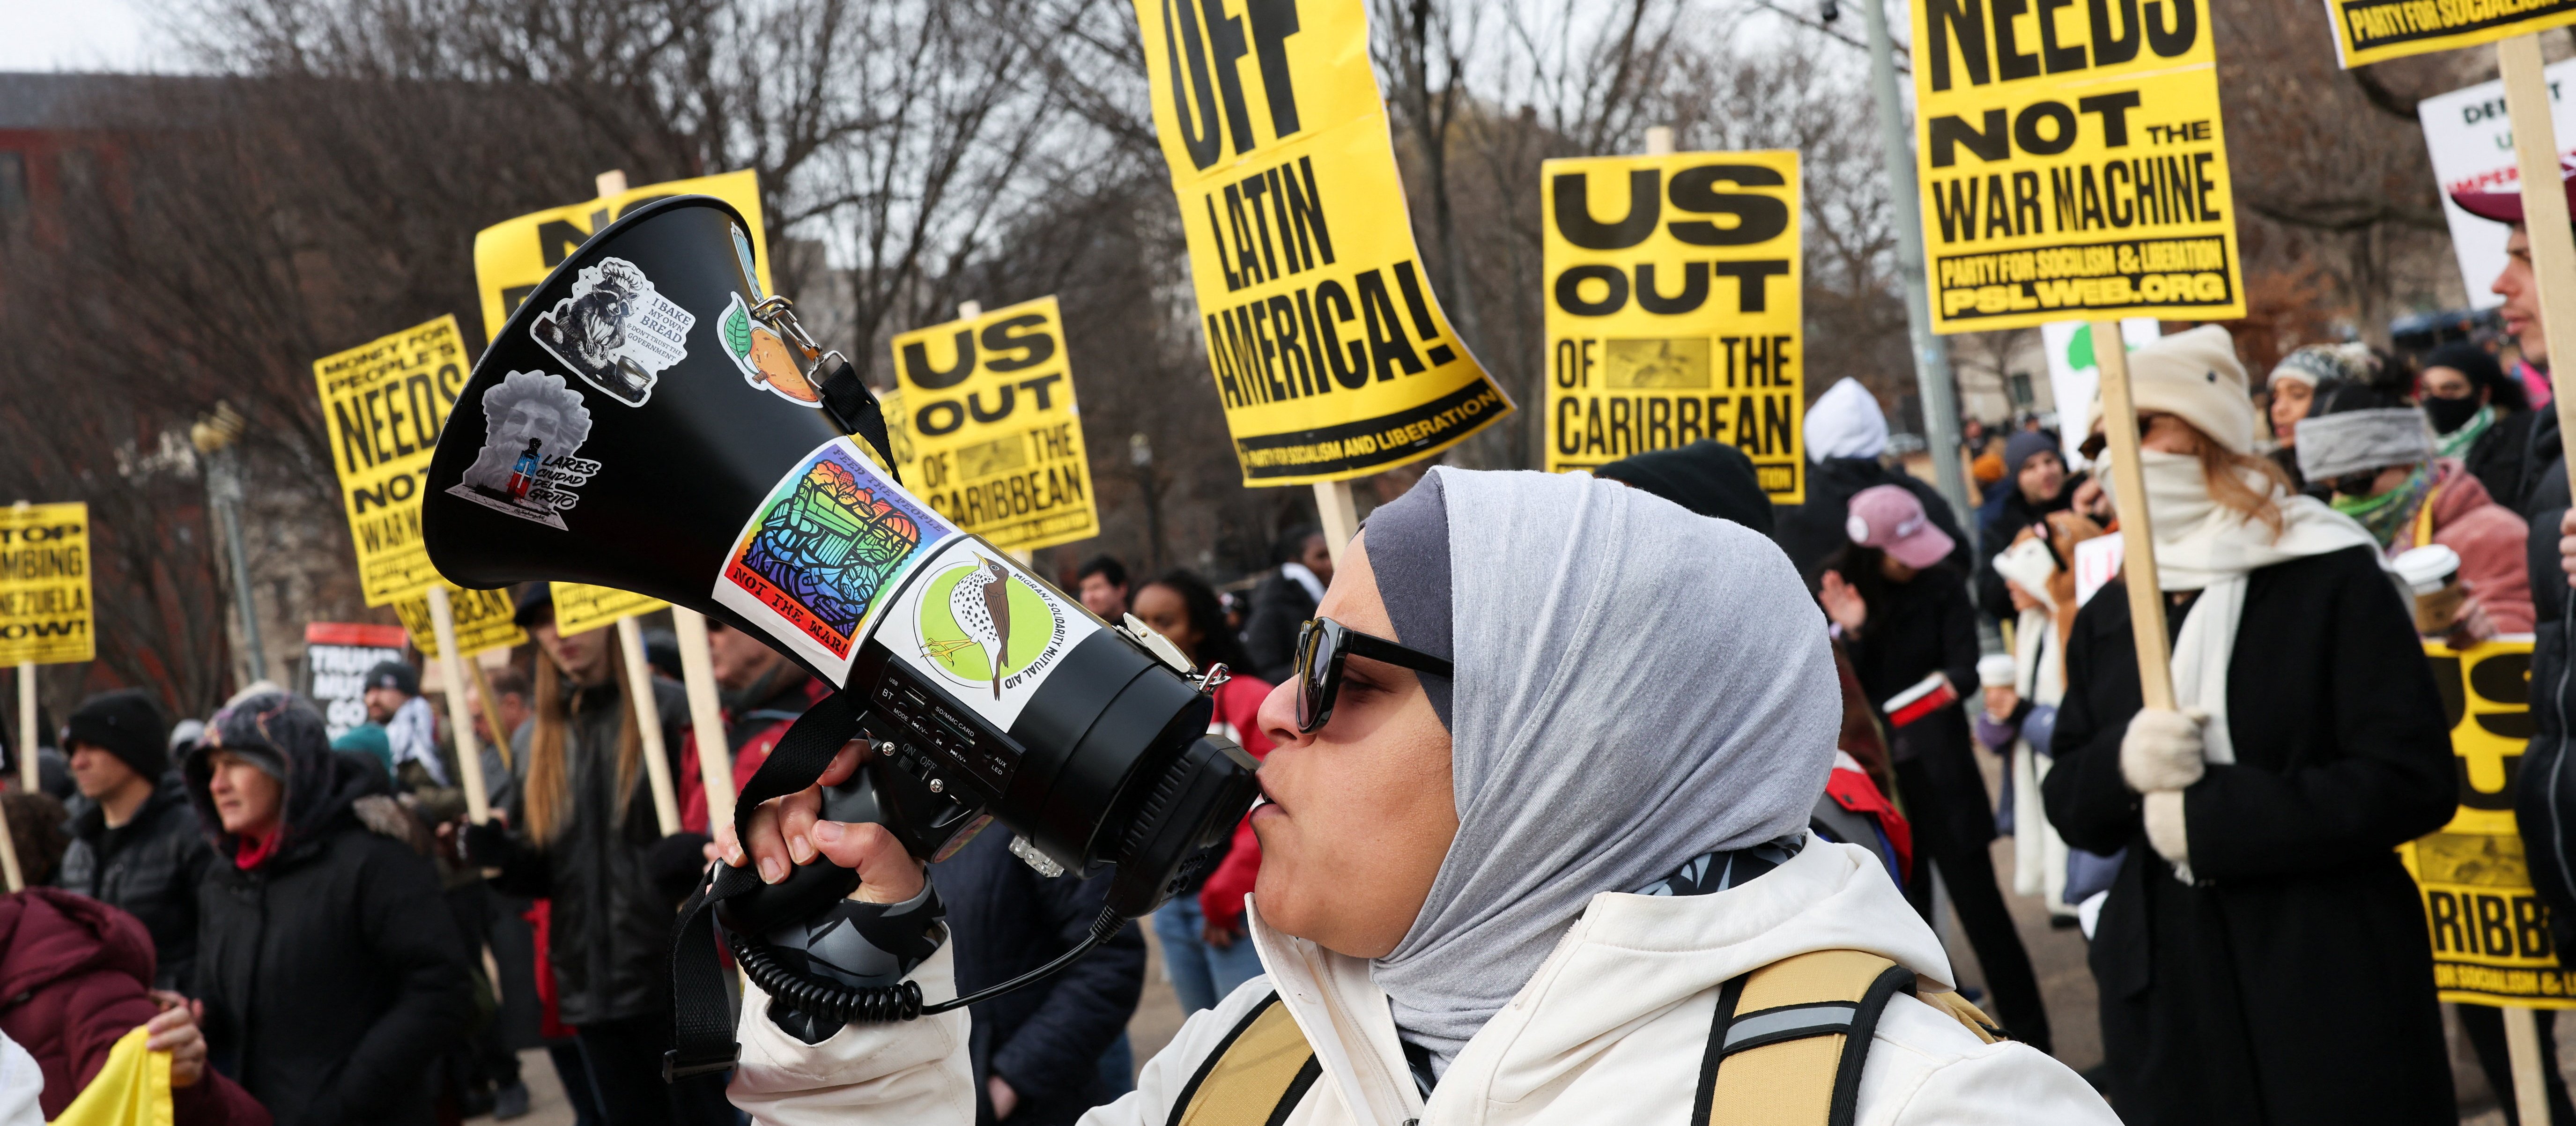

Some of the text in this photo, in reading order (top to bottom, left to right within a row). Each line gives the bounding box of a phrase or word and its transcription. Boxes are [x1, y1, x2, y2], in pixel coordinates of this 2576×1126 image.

[2348, 4, 2408, 42] PARTY
[2404, 1, 2442, 33] FOR
[1162, 0, 1300, 171] OFF
[1929, 89, 2212, 168] NOT THE
[1205, 155, 1335, 293] LATIN
[1553, 164, 1789, 251] US
[1932, 170, 2043, 244] WAR
[1940, 255, 1999, 289] PARTY
[1999, 251, 2036, 283] FOR
[2117, 244, 2139, 274] &
[2139, 239, 2223, 273] LIBERATION
[1554, 260, 1789, 317] OUT
[1943, 272, 2227, 317] PSLWEB.ORG
[640, 315, 682, 343] BREAD
[648, 309, 685, 333] MY OWN
[652, 297, 691, 326] I BAKE
[324, 325, 451, 374] MONEY FOR
[628, 333, 676, 362] GOVERNMENT
[649, 335, 670, 349] TRUST
[669, 346, 683, 356] THE
[903, 313, 1056, 391] US
[1207, 259, 1458, 410] AMERICA!
[329, 342, 457, 394] PEOPLE'S
[1556, 336, 1794, 389] OF THE
[334, 363, 462, 474] NEEDS
[916, 373, 1063, 437] OUT
[1287, 440, 1344, 465] SOCIALISM
[1343, 435, 1376, 458] AND
[1377, 388, 1499, 451] LIBERATION
[1557, 394, 1791, 456] CARIBBEAN
[541, 454, 599, 474] LARES
[924, 422, 1076, 488] OF THE
[532, 479, 554, 490] DEL
[536, 468, 584, 484] CIUDAD
[833, 449, 945, 532] FEED THE PEOPLE
[529, 489, 577, 507] GRITO
[0, 523, 81, 544] TOP
[358, 511, 406, 555] WAR
[0, 547, 82, 579] MBING
[733, 567, 848, 655] NOT THE WAR!
[0, 620, 85, 639] OW!
[1005, 573, 1066, 689] MIGRANT SOLIDARITY MUTUAL AID
[313, 674, 367, 700] MUS
[882, 688, 894, 701] BT
[888, 677, 899, 687] USB
[326, 699, 369, 728] GO
[893, 708, 909, 722] MODE
[935, 706, 976, 738] SD/MMC CARD
[903, 743, 917, 757] ON
[919, 756, 937, 772] OFF
[994, 756, 1008, 768] AUX
[991, 764, 1003, 776] LED
[2540, 971, 2562, 995] &
